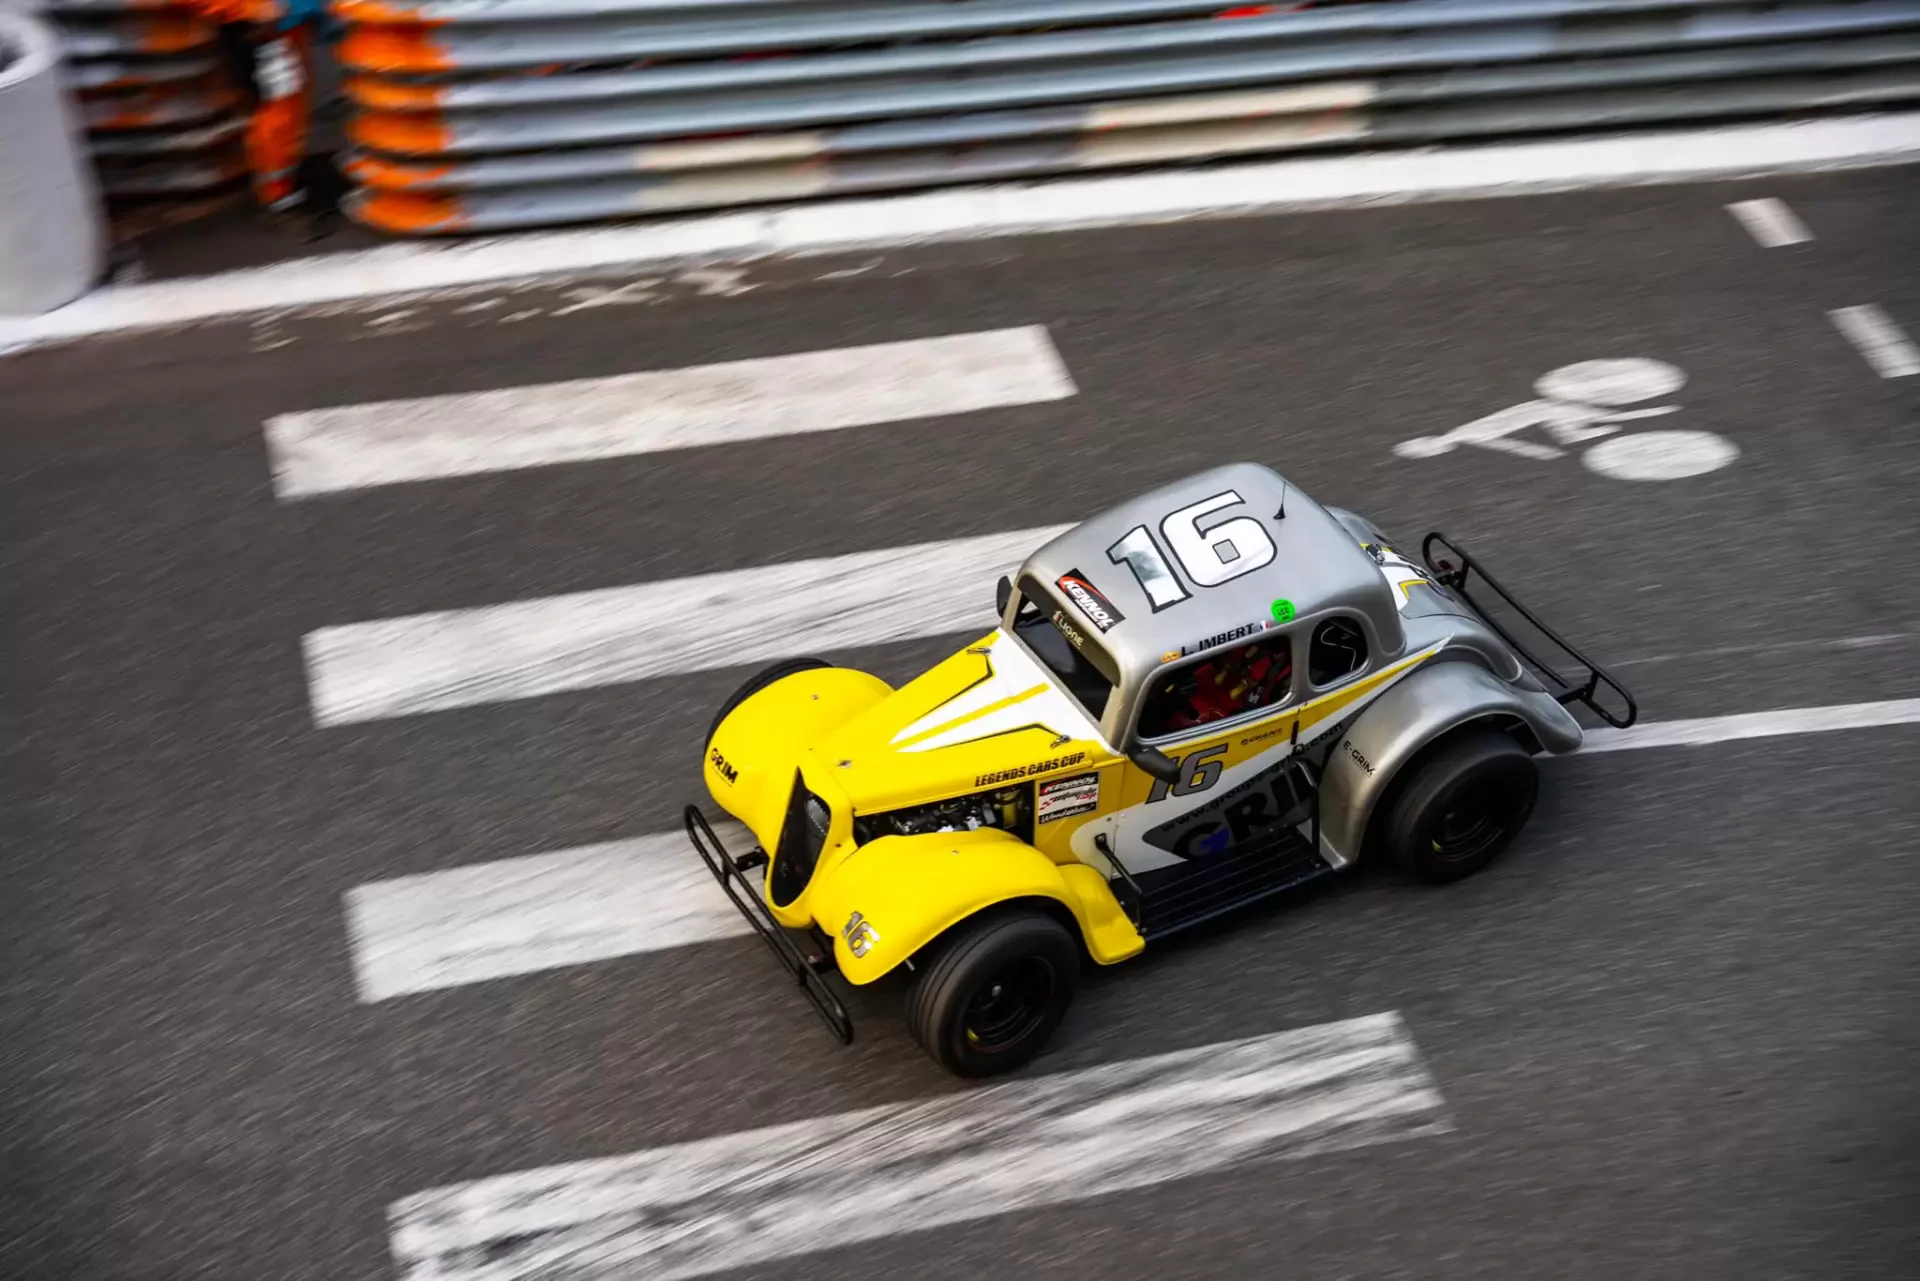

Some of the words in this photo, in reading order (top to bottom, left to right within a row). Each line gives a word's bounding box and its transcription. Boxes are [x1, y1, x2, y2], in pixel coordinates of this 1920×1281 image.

[1105, 489, 1277, 614] 16
[1063, 580, 1114, 628] KENNOL
[1199, 623, 1254, 651] IMBERT
[975, 766, 1026, 787] LEGENDS
[1027, 758, 1059, 776] CARS
[1060, 752, 1085, 768] CUP
[1145, 743, 1228, 804] 16
[1343, 740, 1375, 775] E-GRIM
[842, 910, 880, 959] 16
